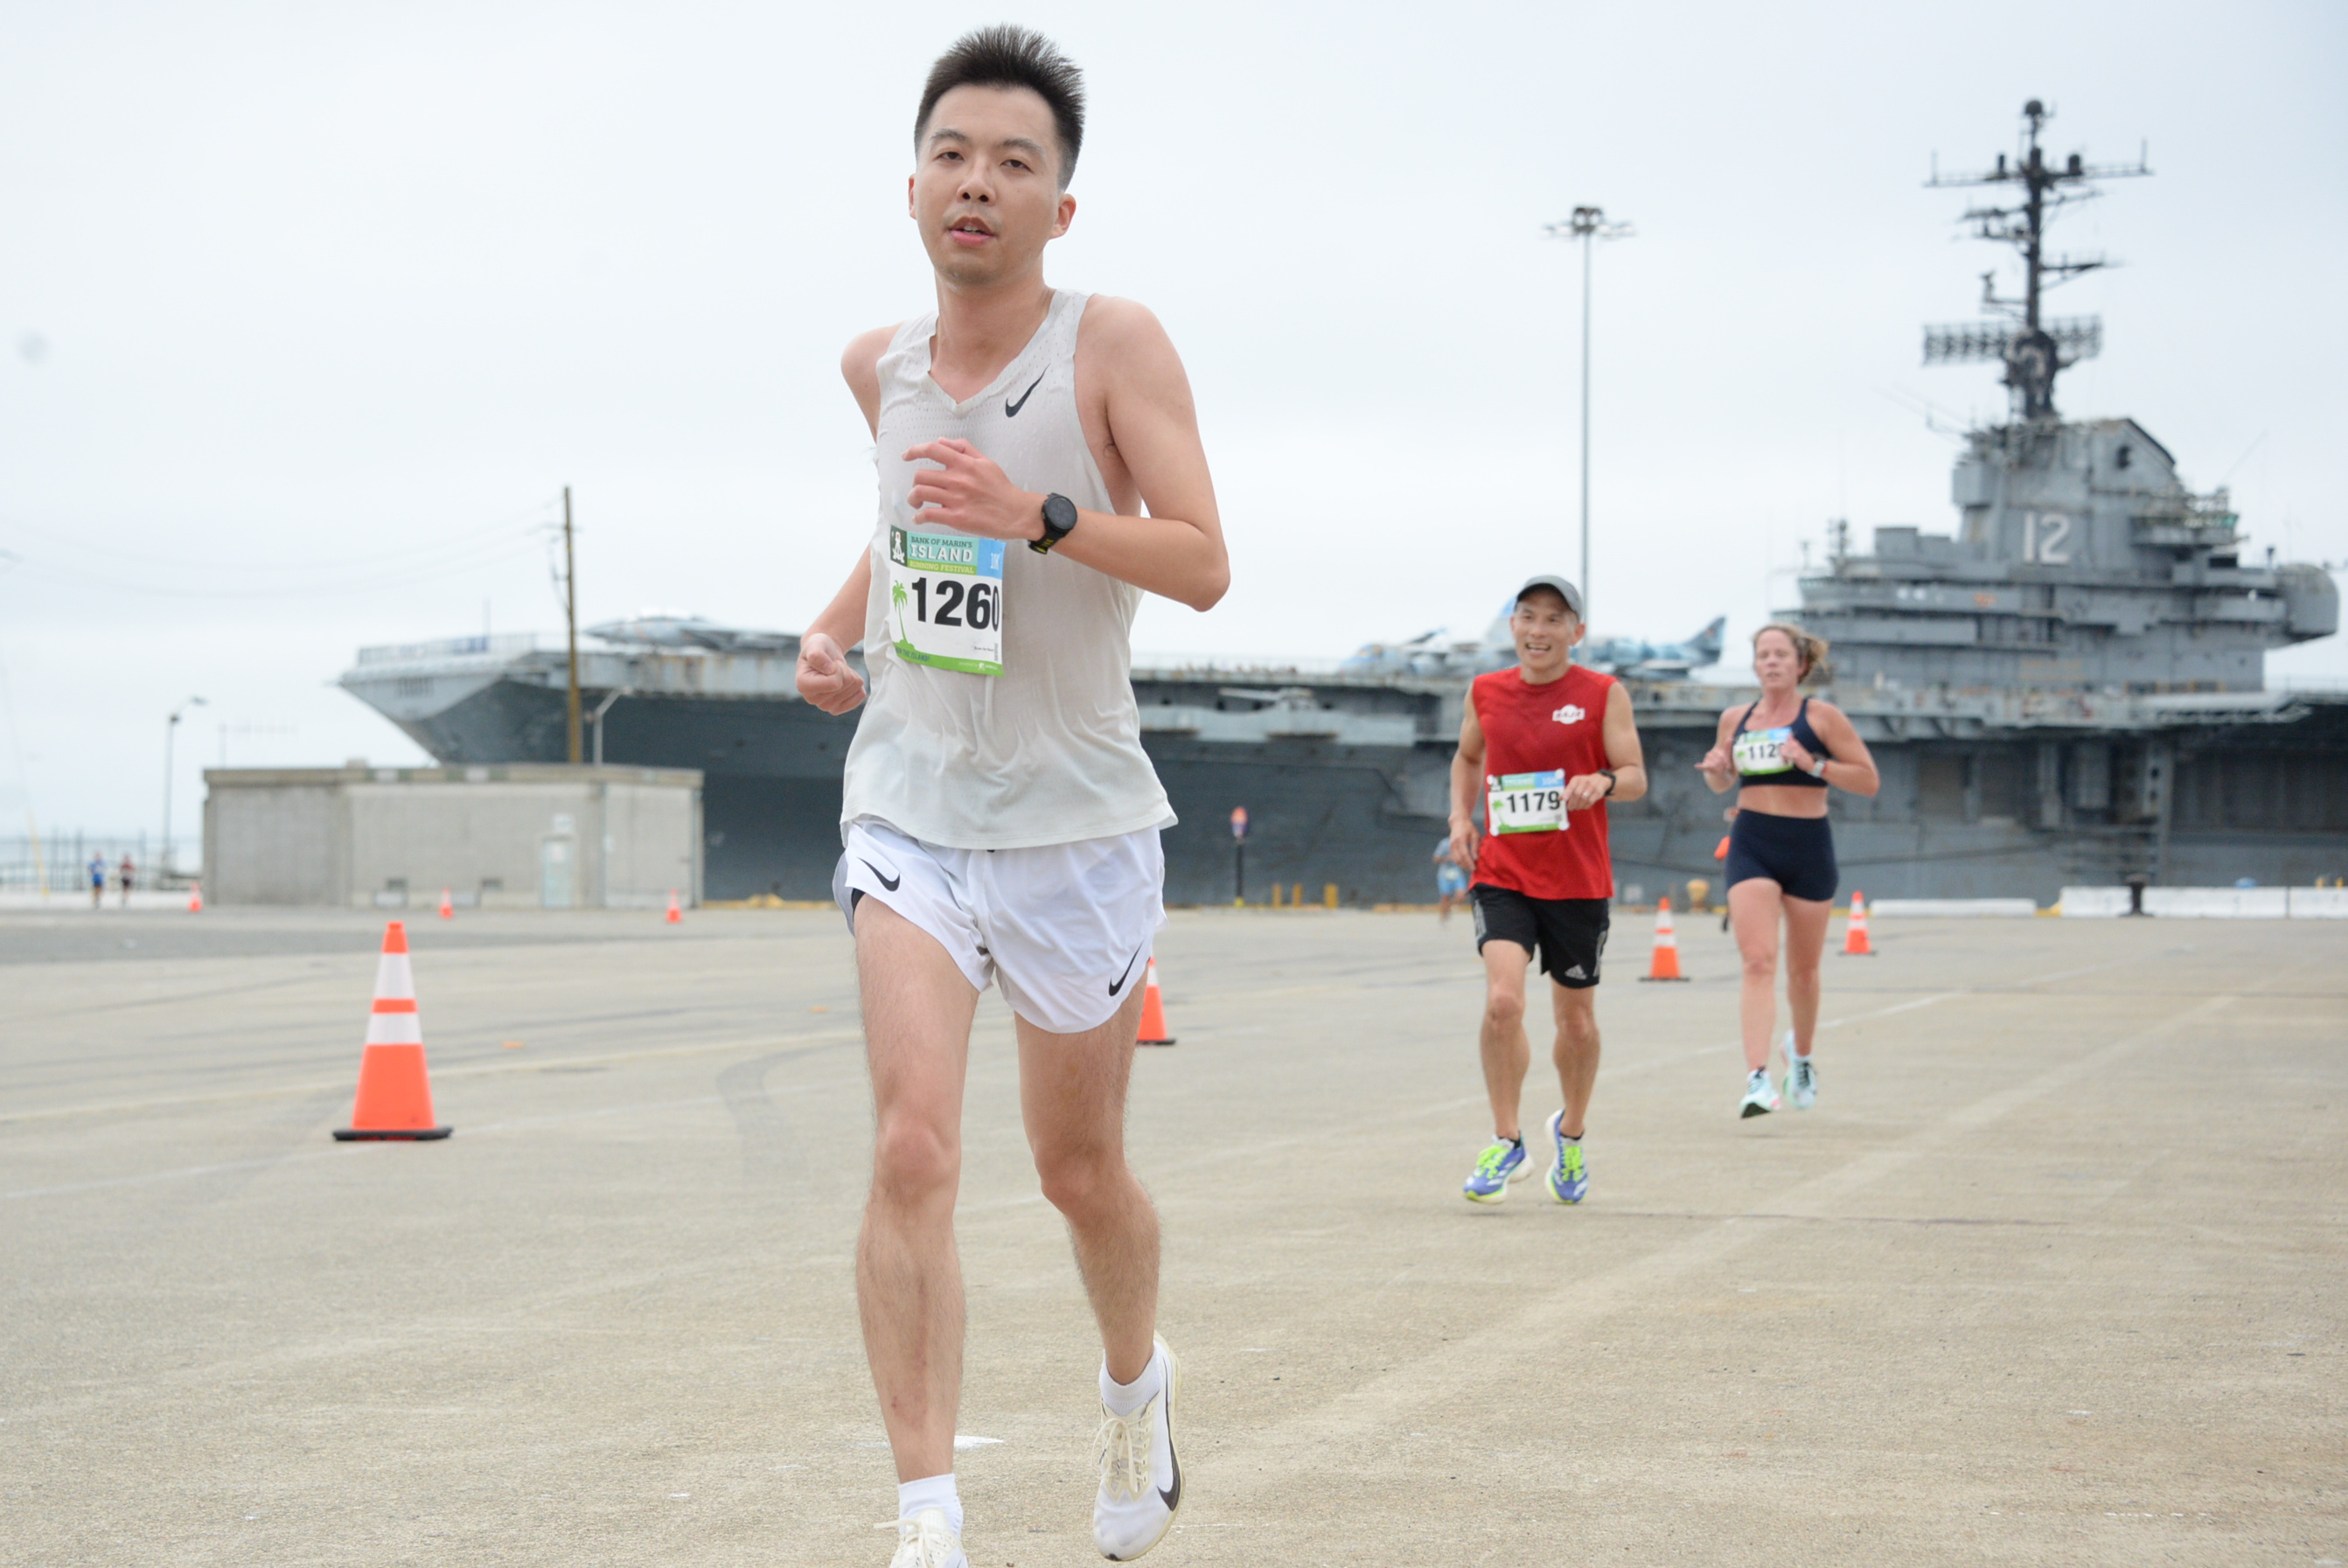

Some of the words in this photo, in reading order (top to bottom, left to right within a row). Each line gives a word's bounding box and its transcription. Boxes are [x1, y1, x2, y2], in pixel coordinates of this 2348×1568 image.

[911, 536, 930, 545] BANK
[942, 540, 972, 548] MARIN'S
[2024, 512, 2070, 563] 12
[910, 544, 973, 562] ISLAND
[910, 561, 938, 570] RUNNING
[941, 565, 973, 574] FESTIVAL
[911, 577, 1000, 632] 1260
[1506, 791, 1561, 813] 1179
